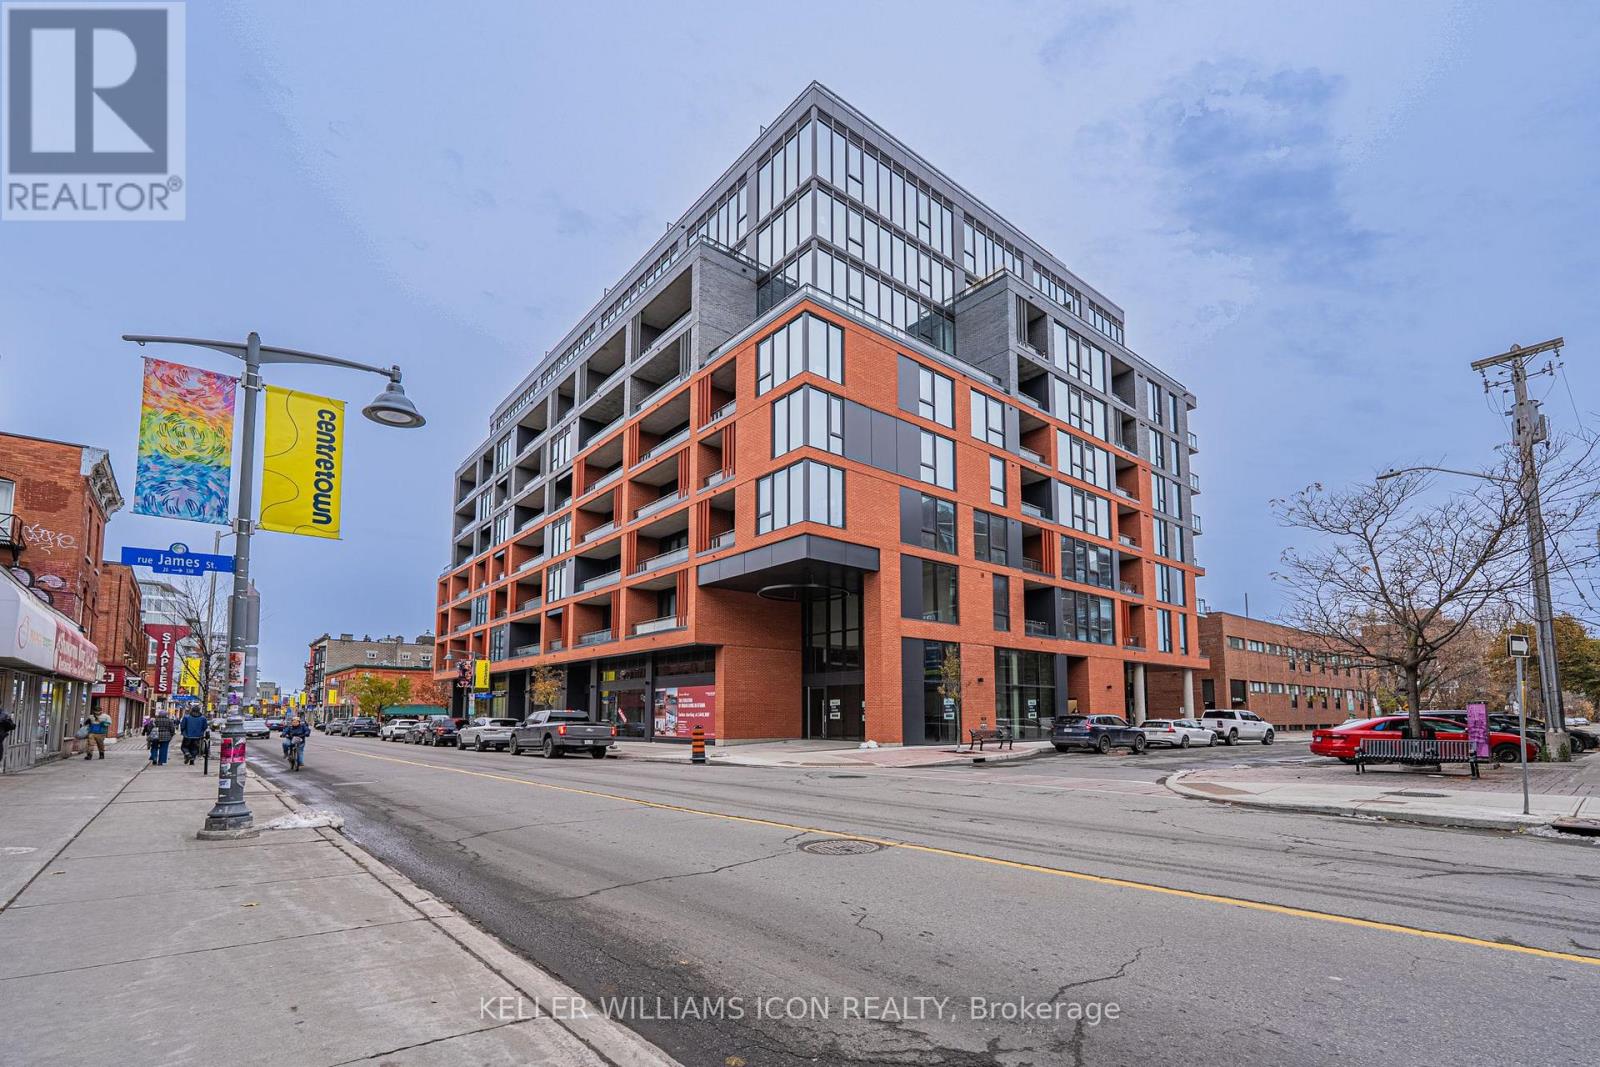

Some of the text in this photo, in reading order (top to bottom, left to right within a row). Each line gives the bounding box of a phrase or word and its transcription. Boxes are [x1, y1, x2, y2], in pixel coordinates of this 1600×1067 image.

[312, 408, 337, 525] centretown
[137, 553, 217, 569] rue James St.
[159, 632, 172, 692] STAPLES
